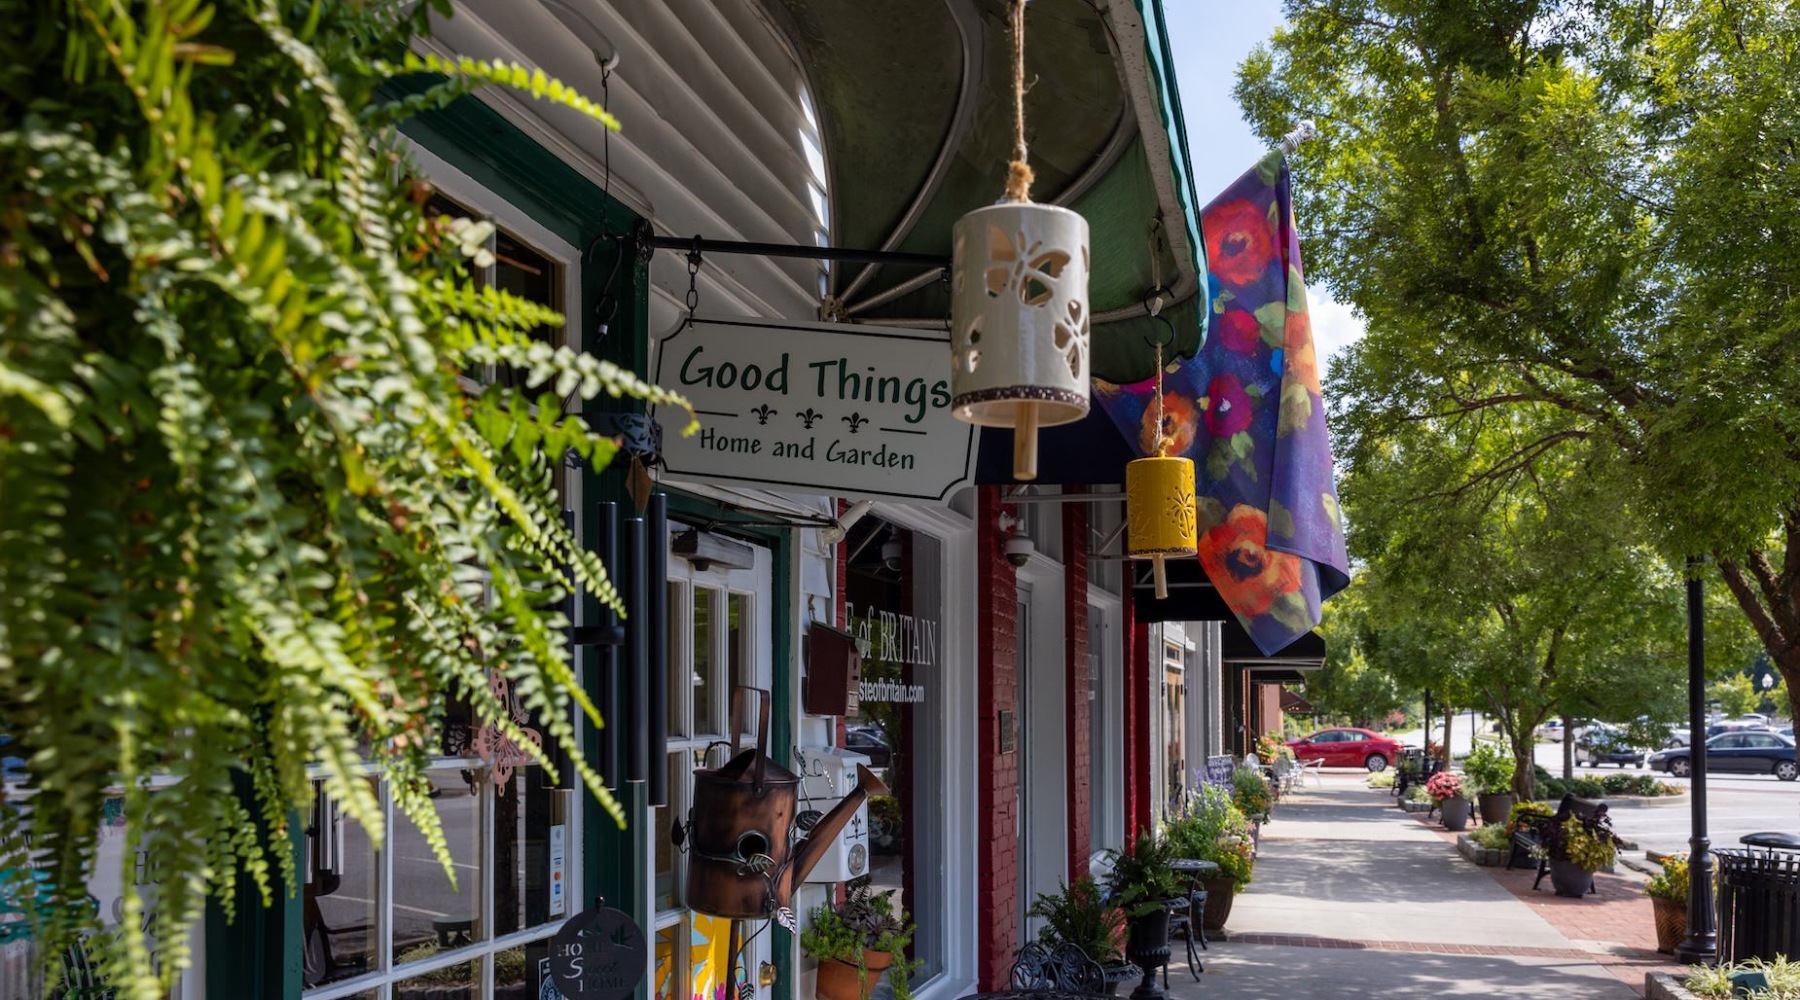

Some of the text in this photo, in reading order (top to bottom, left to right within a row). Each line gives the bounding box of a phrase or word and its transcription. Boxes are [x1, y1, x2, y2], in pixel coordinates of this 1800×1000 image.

[681, 346, 951, 423] Good Things
[701, 428, 914, 469] Home and Garden
[859, 605, 873, 659] of
[879, 610, 936, 666] BRITAIN
